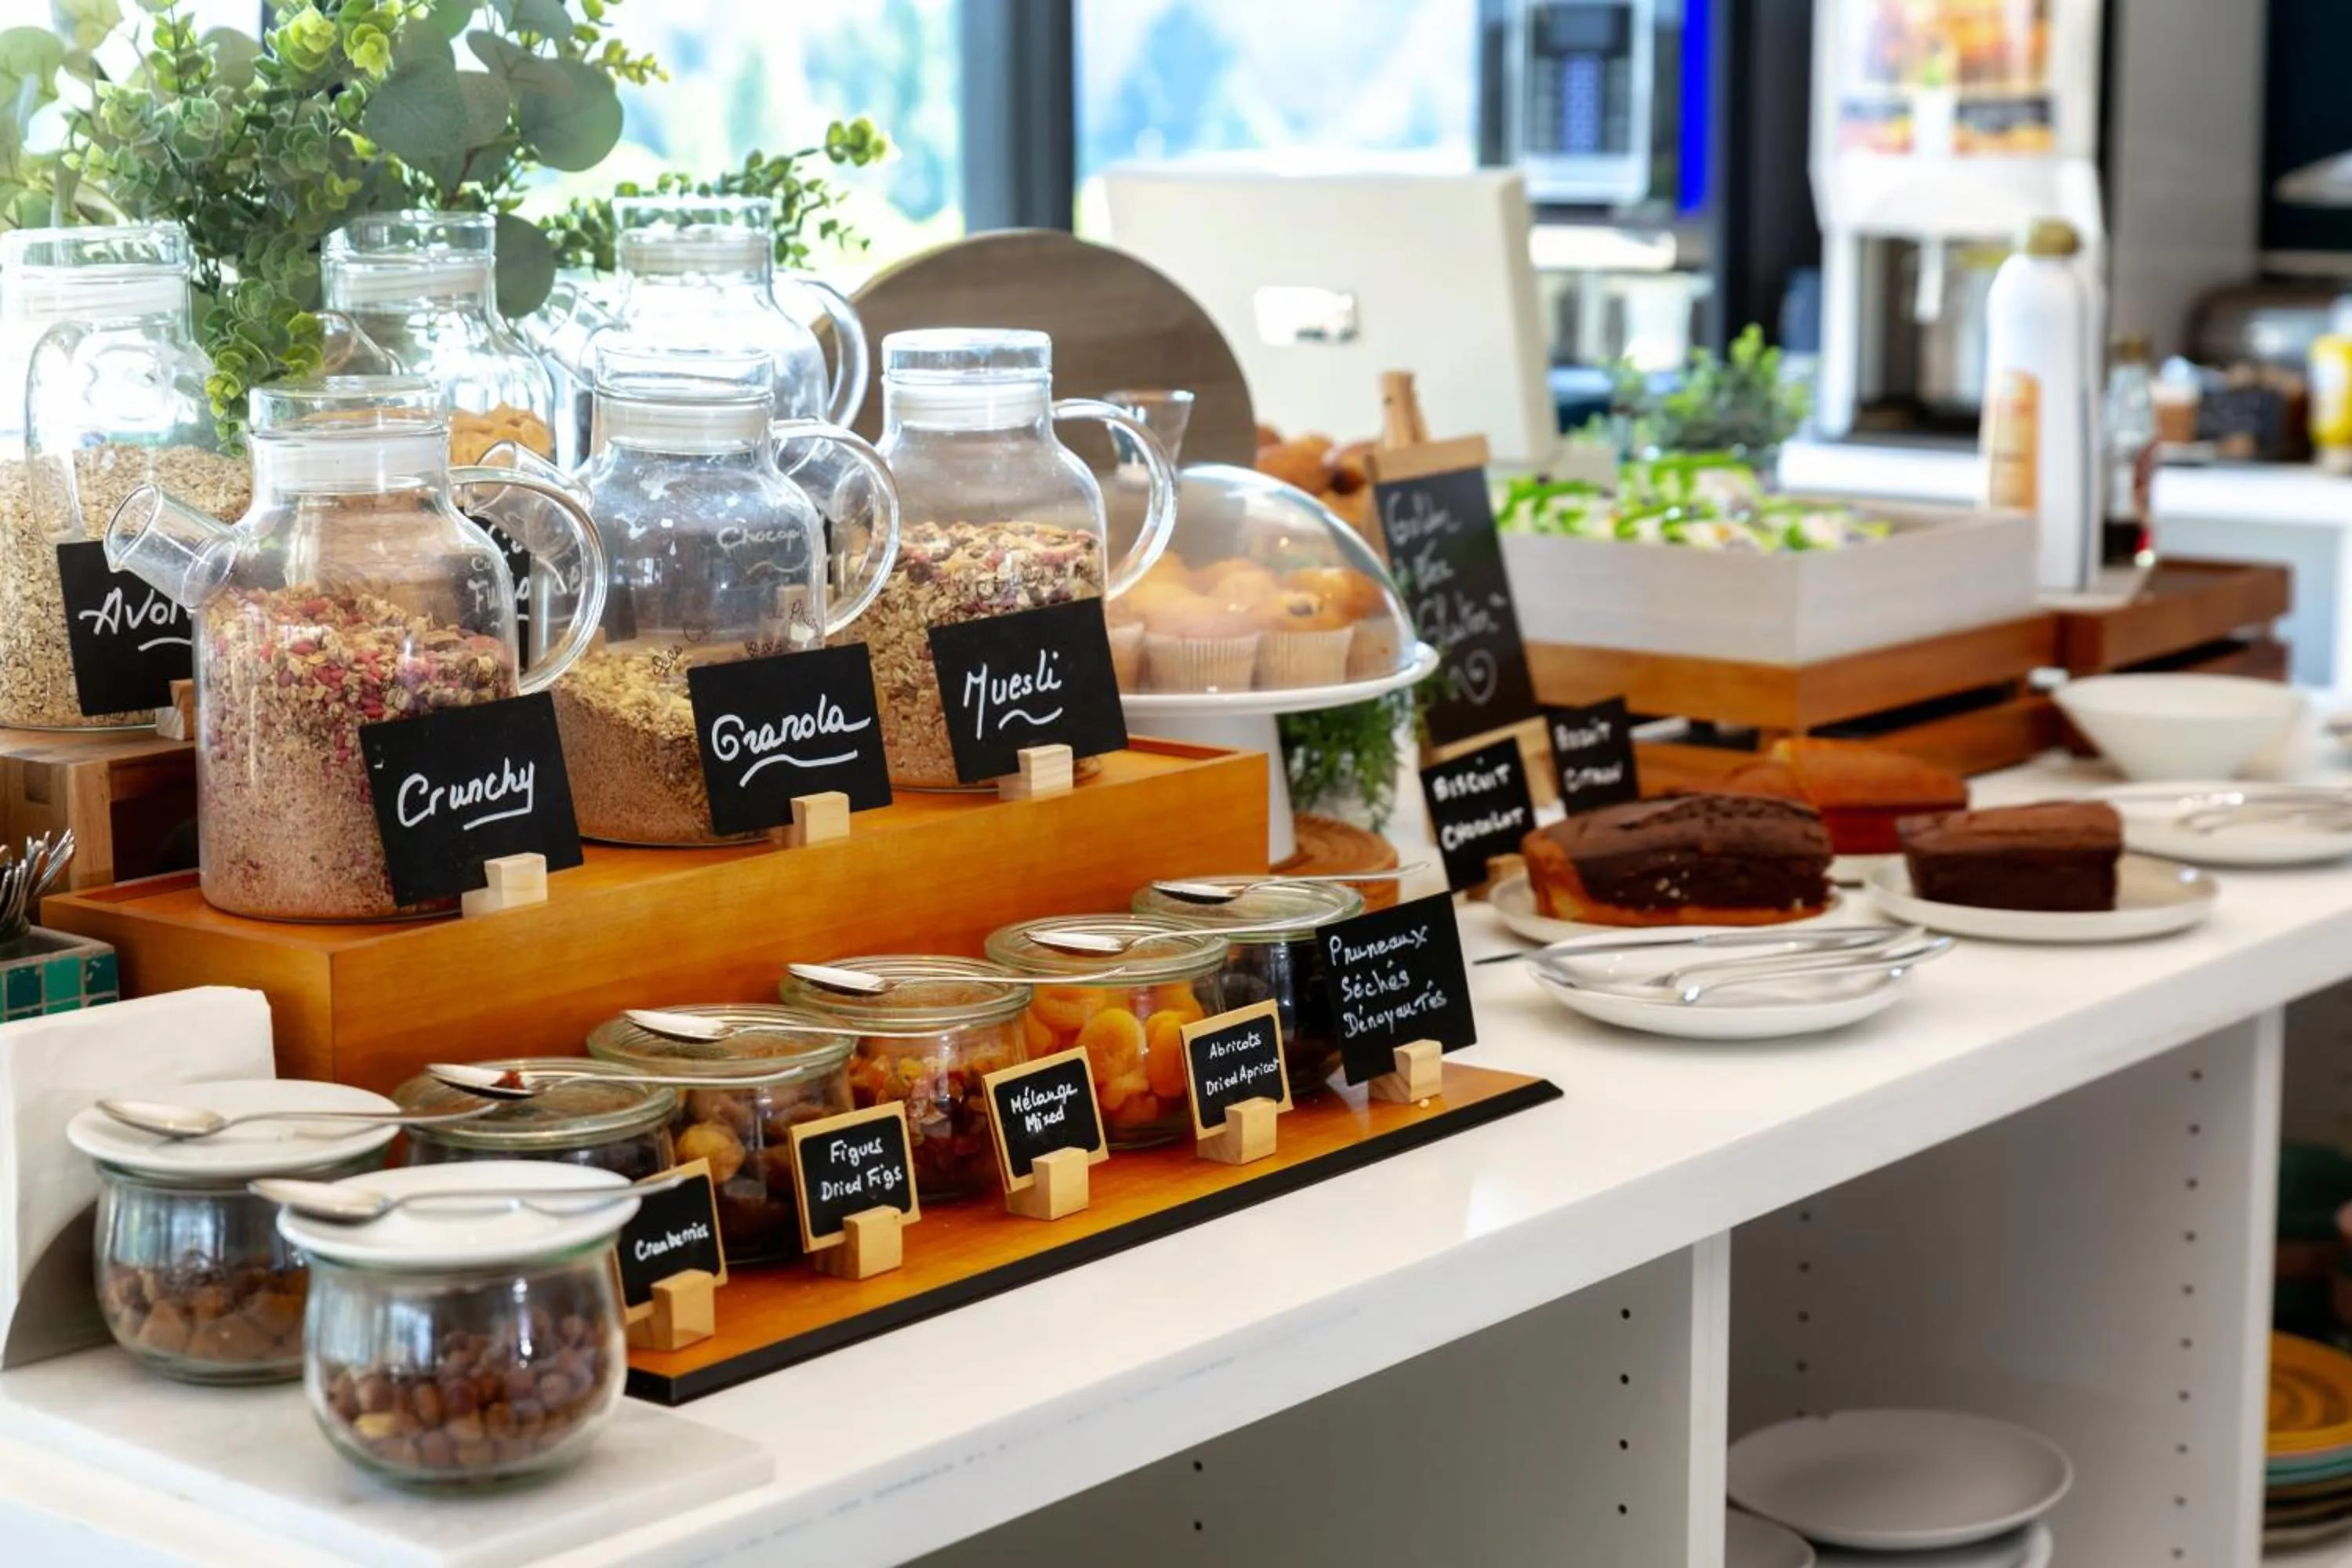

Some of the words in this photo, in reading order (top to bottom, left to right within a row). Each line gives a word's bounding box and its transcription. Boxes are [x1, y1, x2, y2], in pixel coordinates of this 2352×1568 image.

[78, 587, 191, 635] Avoi
[963, 648, 1062, 740] Muesli
[711, 693, 871, 761] Granola
[397, 757, 535, 829] Crunchy
[1329, 925, 1428, 966] Pruneaux
[1341, 960, 1410, 1002] Séchés
[1209, 1032, 1261, 1059] Abricots
[1206, 1071, 1238, 1096] Dried
[1240, 1057, 1279, 1085] Apricot
[1010, 1083, 1078, 1114] Mélange
[1025, 1105, 1065, 1133] Mixed
[830, 1137, 884, 1167] Figues
[821, 1174, 862, 1201] Dried
[866, 1163, 902, 1190] Figs
[634, 1221, 709, 1261] Cranberries
